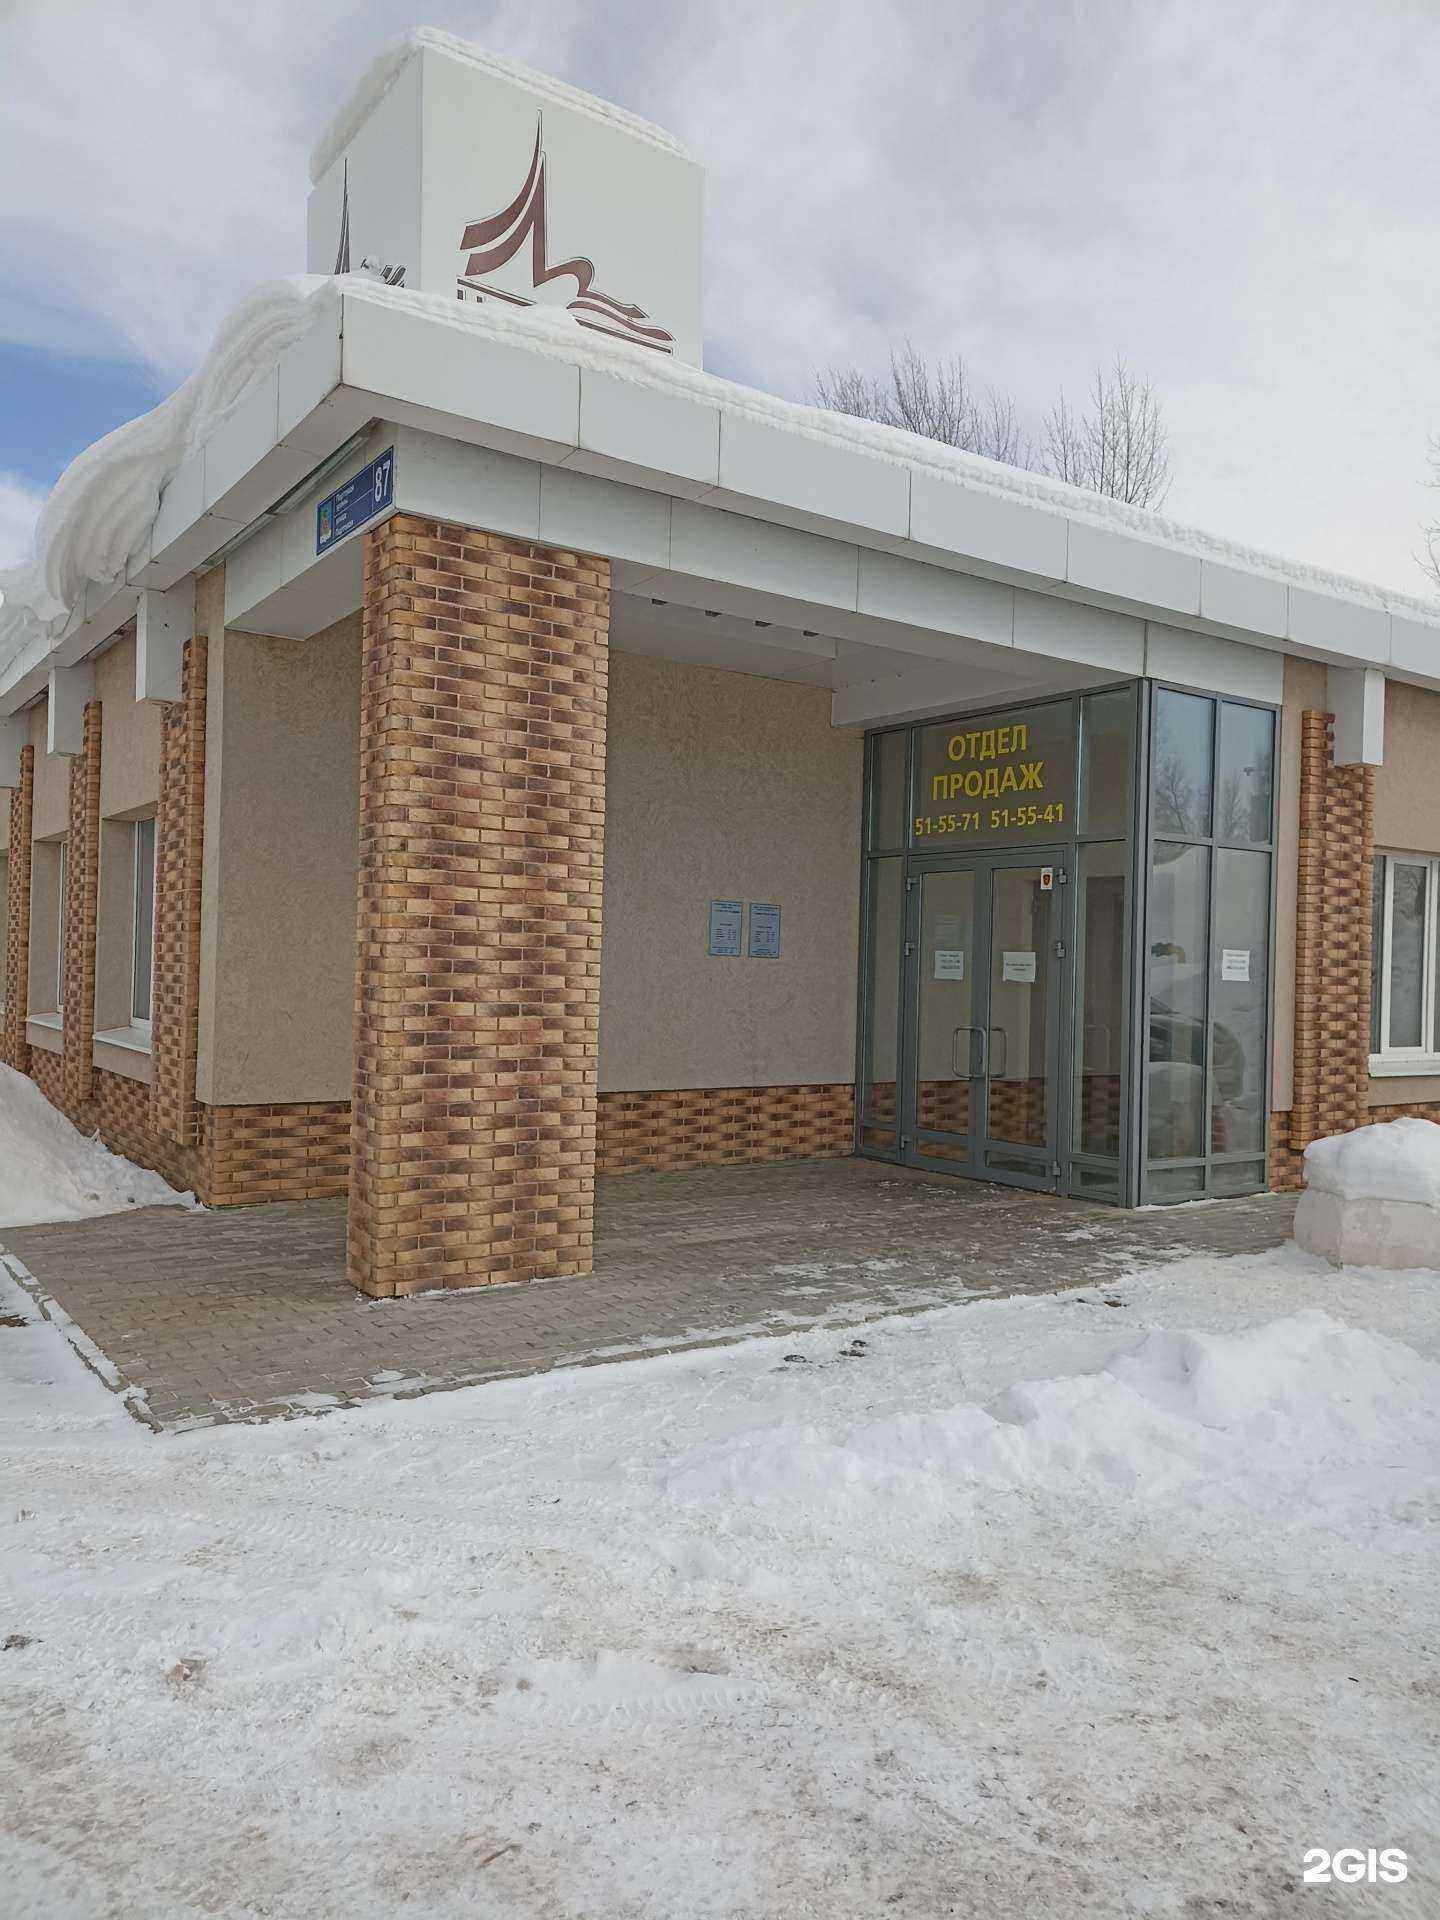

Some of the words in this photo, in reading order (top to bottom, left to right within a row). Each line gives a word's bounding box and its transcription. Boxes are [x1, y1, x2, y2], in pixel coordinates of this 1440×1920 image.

[374, 459, 391, 503] 87
[947, 724, 1028, 762] ОТДЕЛ
[931, 761, 1044, 801] ПРОДАЖ
[915, 812, 980, 836] 51-55-71
[990, 803, 1064, 829] 51-55-41
